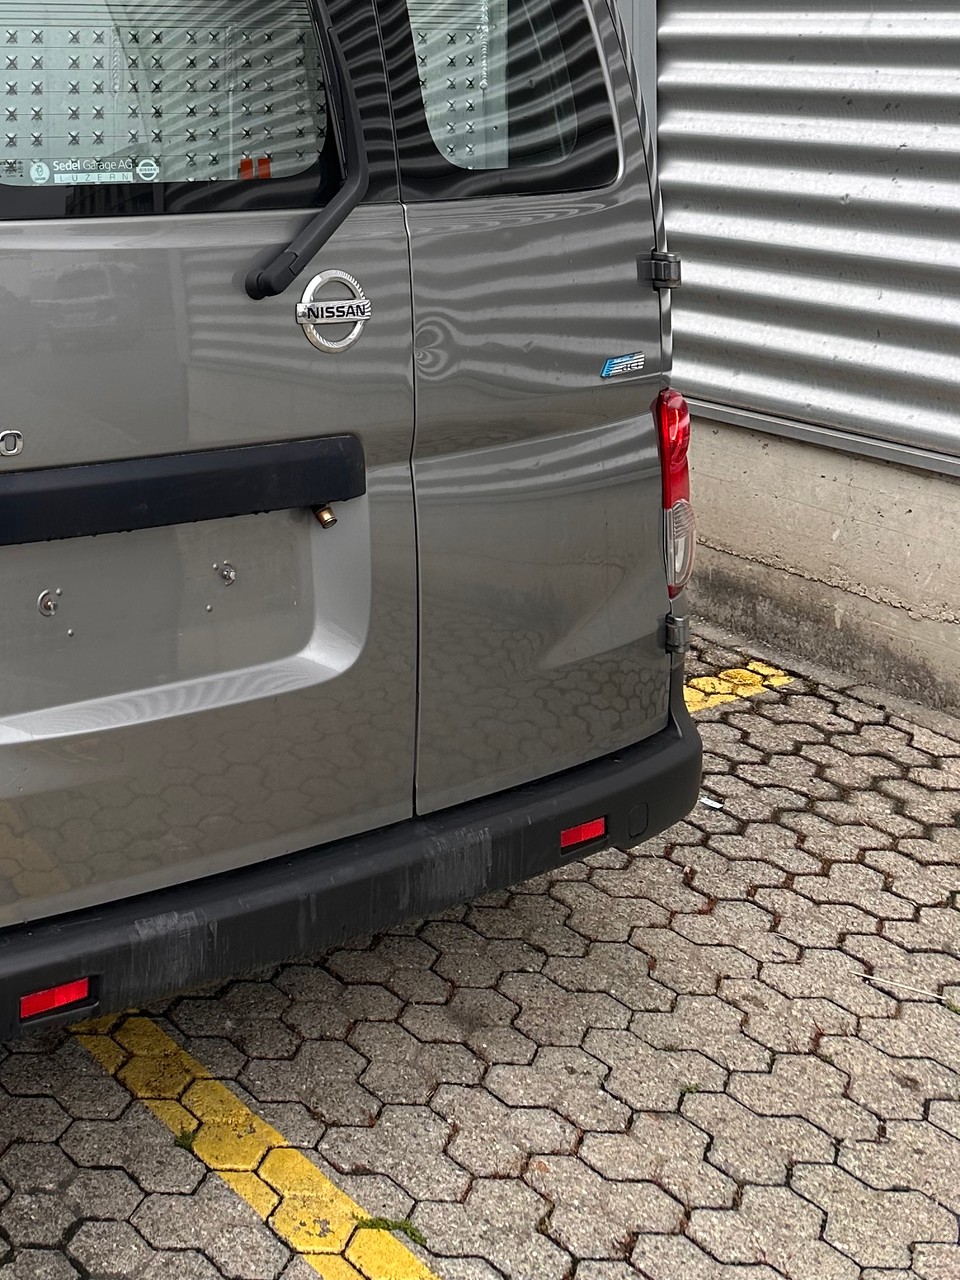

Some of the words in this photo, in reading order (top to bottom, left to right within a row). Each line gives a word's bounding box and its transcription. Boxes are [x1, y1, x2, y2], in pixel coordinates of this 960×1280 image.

[53, 160, 81, 171] Sedel
[82, 160, 116, 172] Garage
[118, 159, 132, 170] AG
[60, 173, 129, 182] LUZERN
[307, 305, 366, 319] NISSAN
